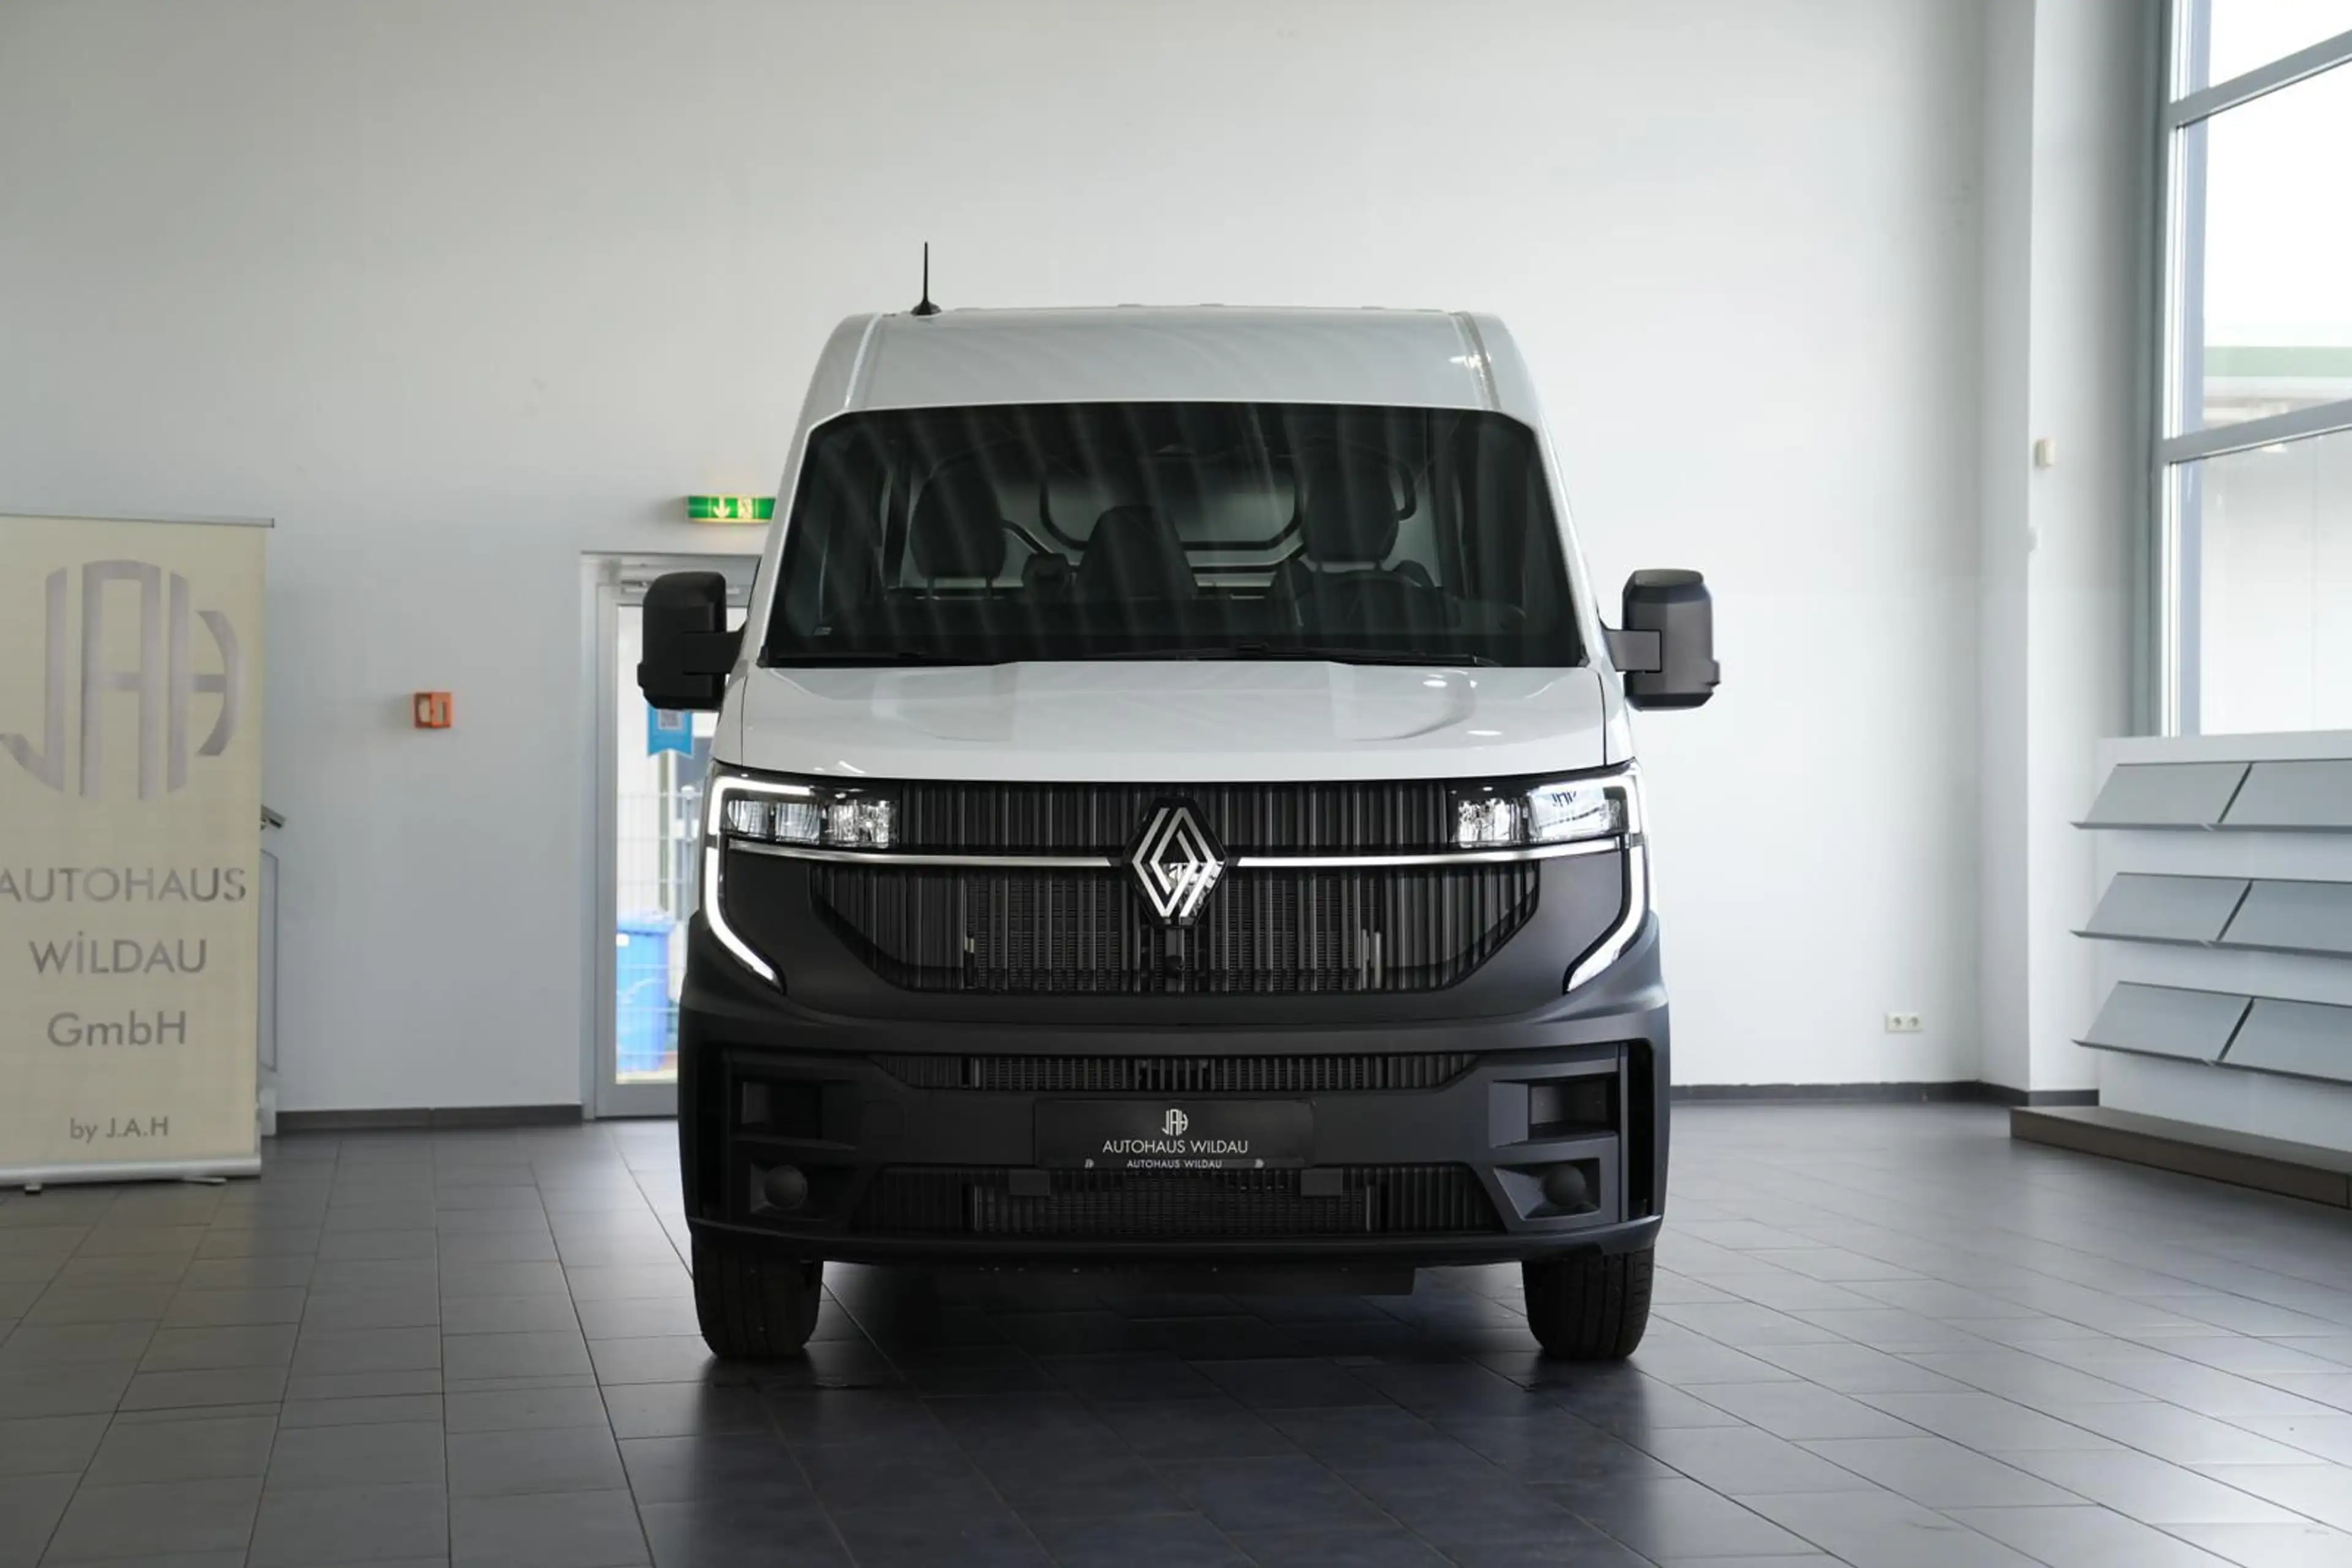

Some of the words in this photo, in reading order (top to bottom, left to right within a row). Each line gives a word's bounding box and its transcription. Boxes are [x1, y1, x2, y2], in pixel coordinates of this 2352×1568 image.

[0, 867, 246, 902] AUTOHAUS
[48, 1010, 186, 1046] GmbH
[70, 1117, 98, 1145] by
[106, 1117, 168, 1138] J.A.H
[1102, 1140, 1185, 1153] AUTOHAUS
[1190, 1140, 1248, 1153] WILDAU
[1127, 1159, 1180, 1169] AUTOHAUS
[1184, 1159, 1222, 1169] WILDAU
